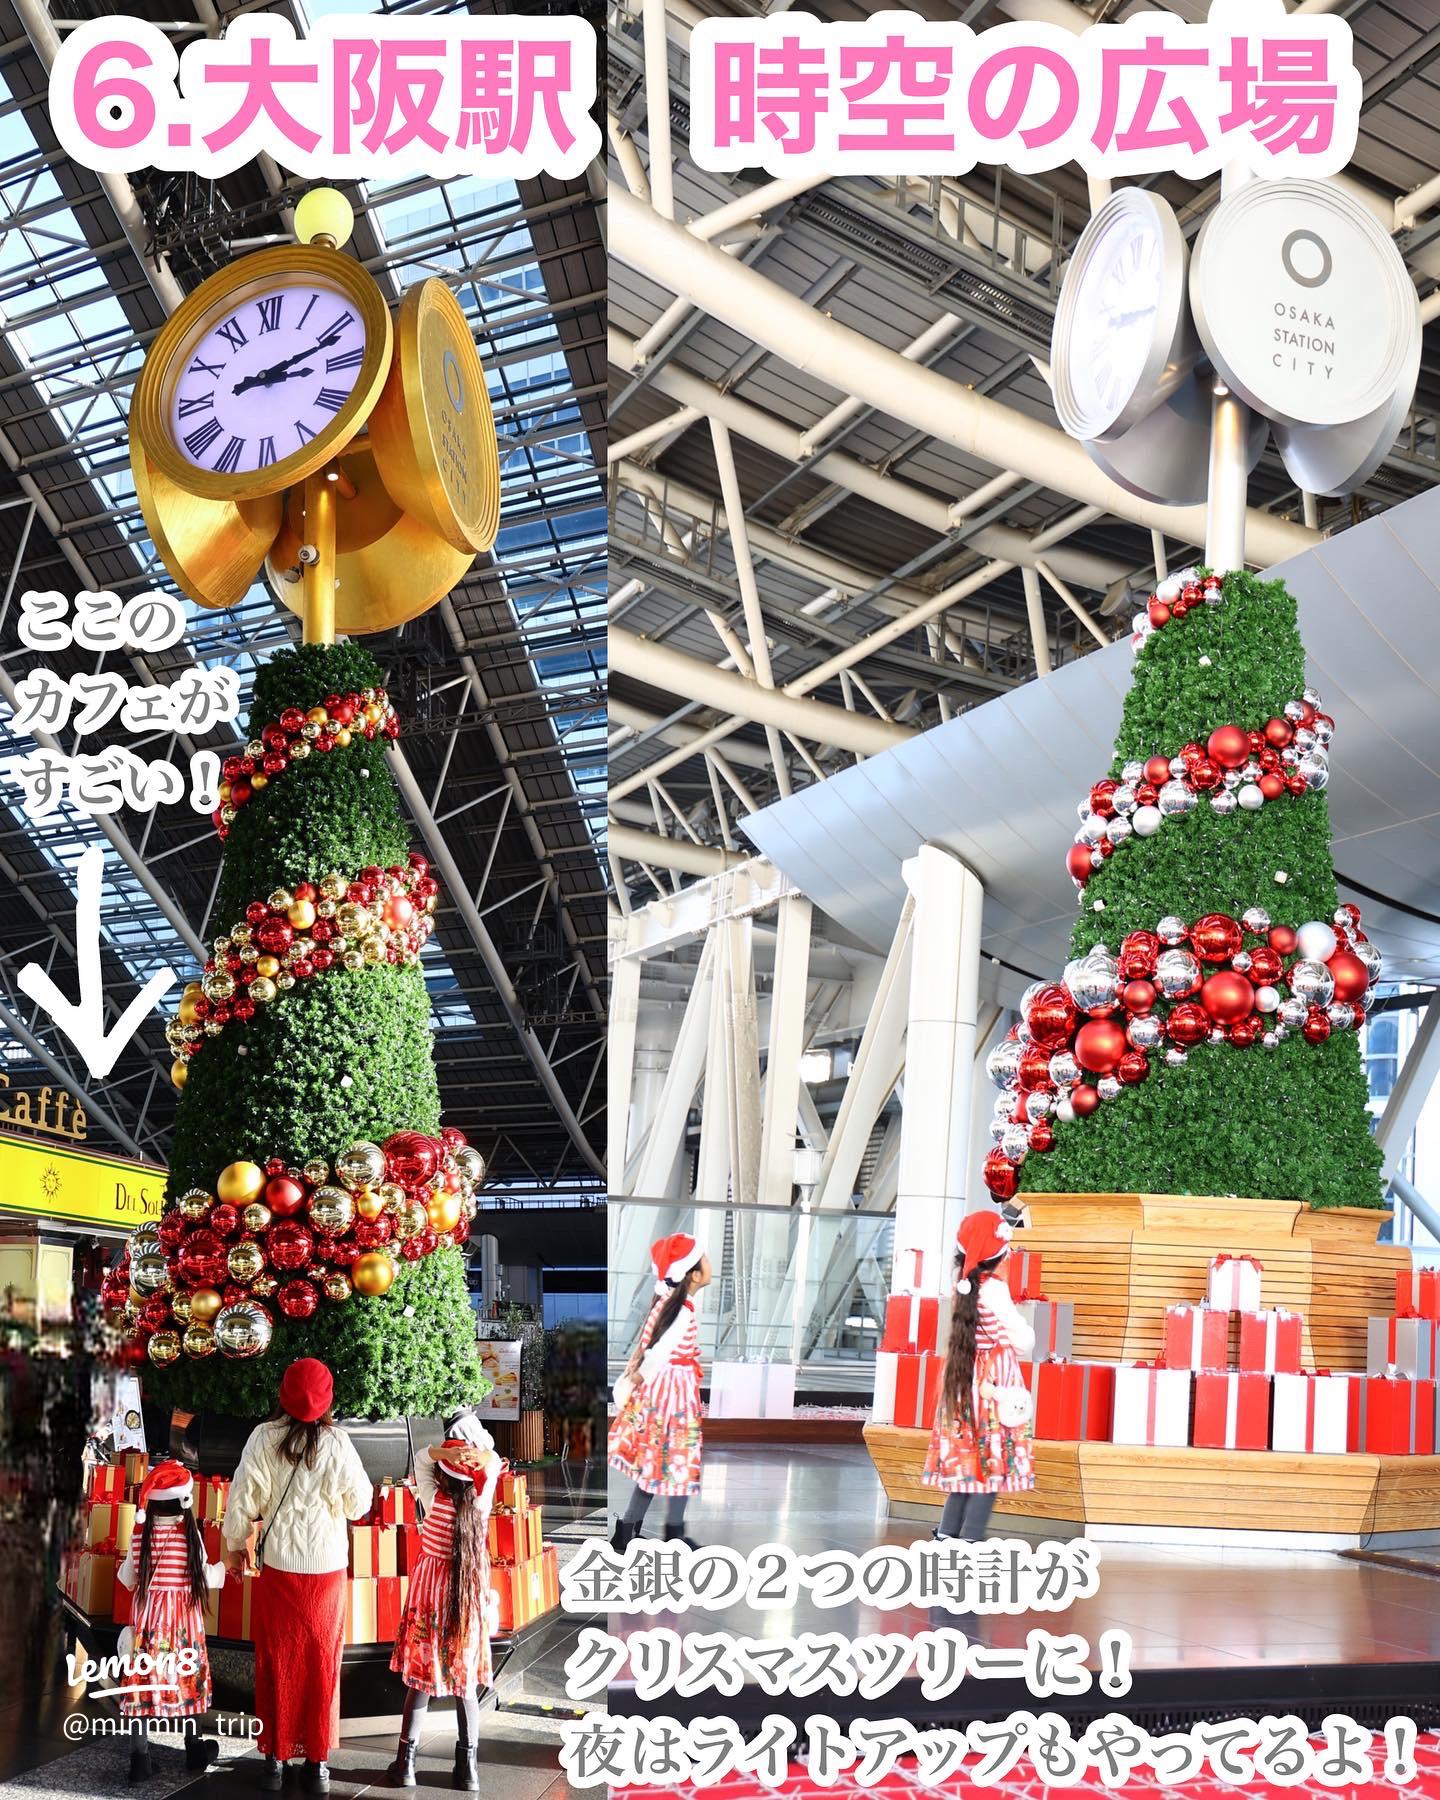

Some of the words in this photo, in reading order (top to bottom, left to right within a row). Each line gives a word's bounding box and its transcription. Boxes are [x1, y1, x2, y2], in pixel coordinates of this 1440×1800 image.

[256, 295, 284, 335] XII
[1274, 303, 1336, 330] OSAKA
[215, 316, 249, 354] XI
[1274, 328, 1335, 356] STATION
[188, 356, 226, 380] X
[325, 346, 365, 374] III
[1272, 353, 1333, 379] CITY
[178, 391, 215, 420] IX
[442, 410, 467, 460] OSAKA
